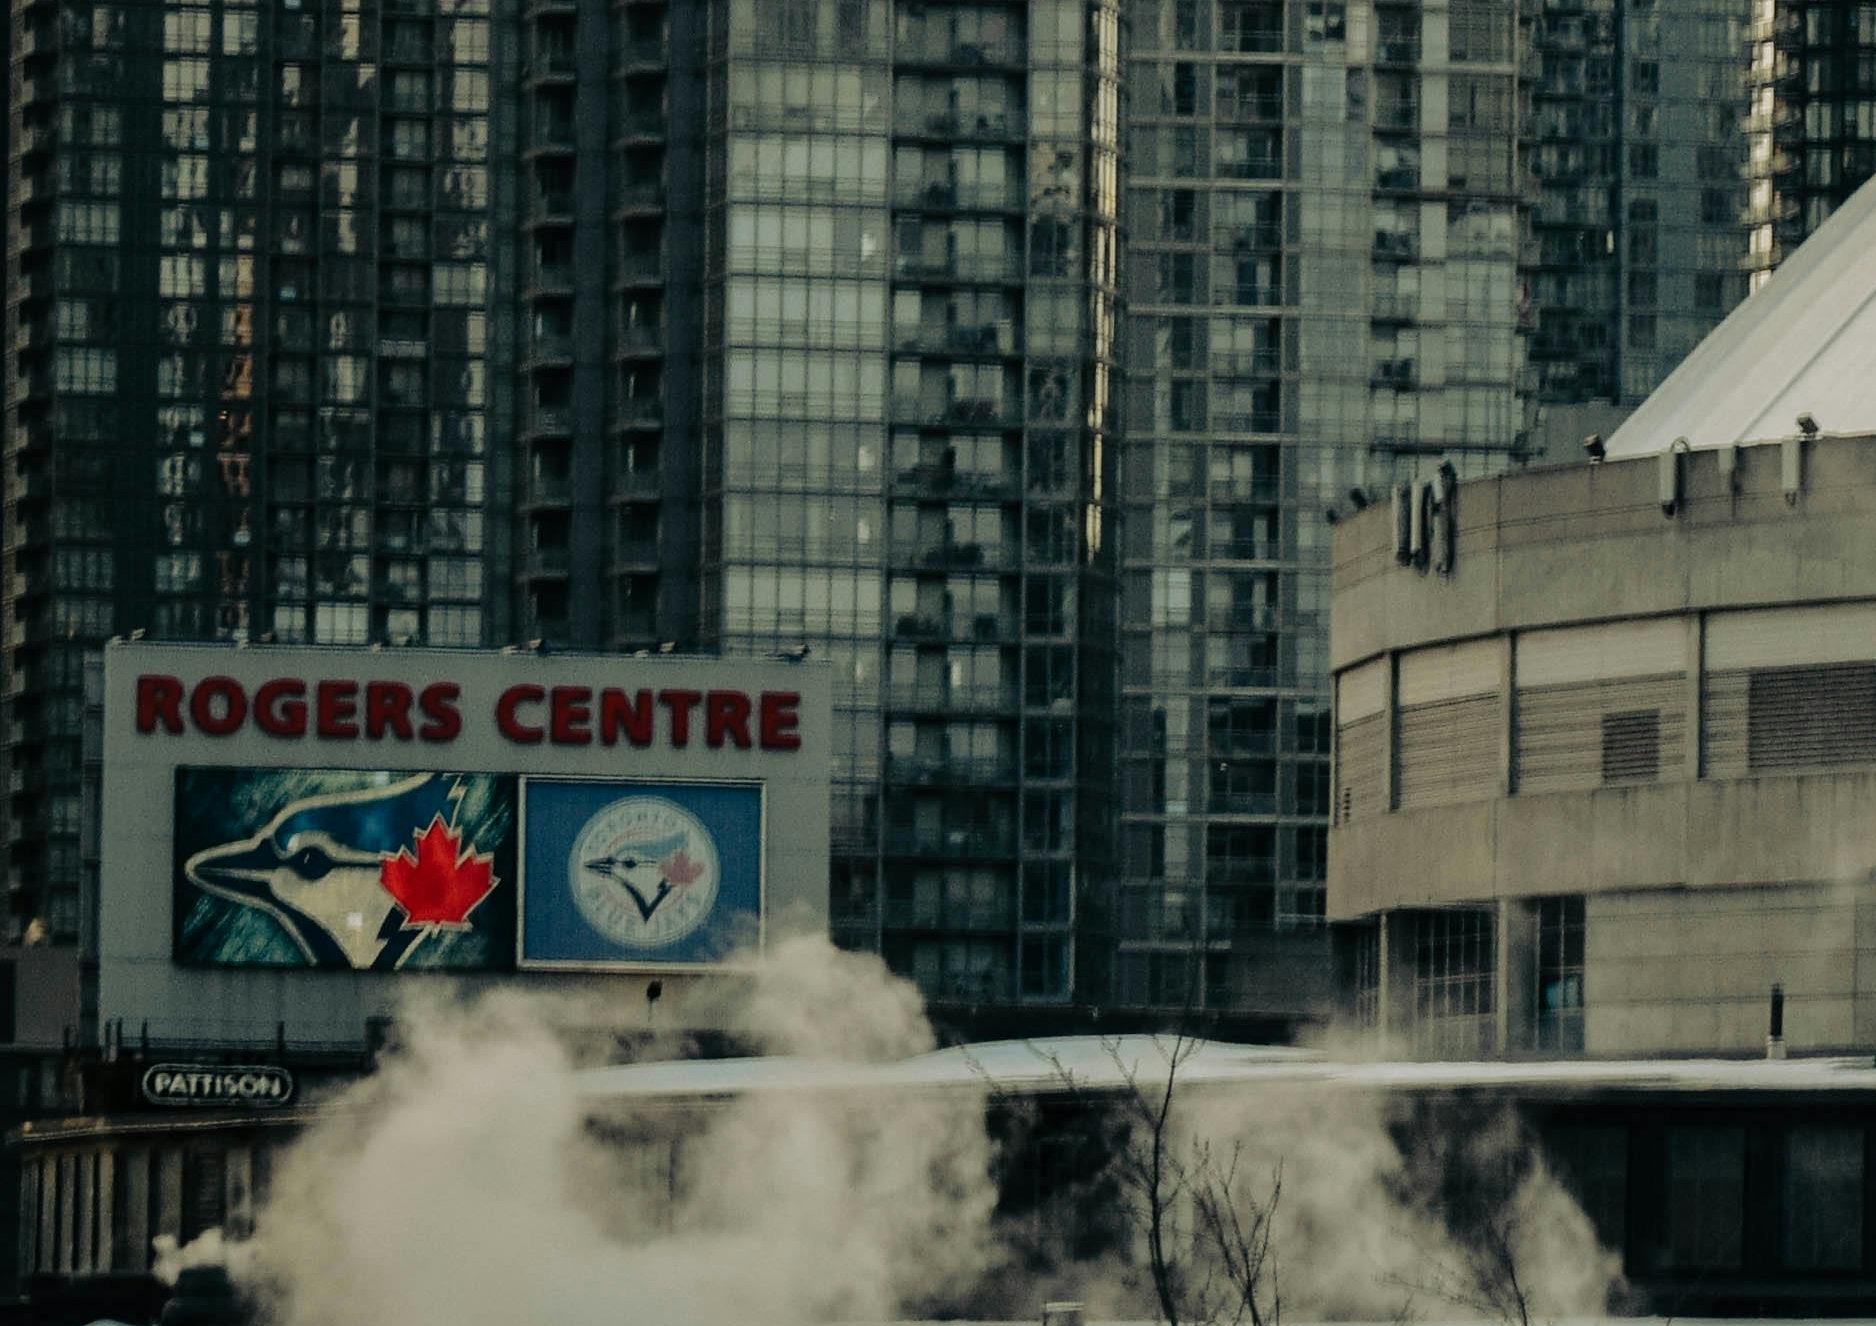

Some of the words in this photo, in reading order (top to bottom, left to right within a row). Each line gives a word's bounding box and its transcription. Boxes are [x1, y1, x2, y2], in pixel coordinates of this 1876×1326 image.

[136, 674, 464, 742] ROGERS
[495, 682, 802, 750] CENTRE
[153, 1072, 283, 1098] PATTISON
